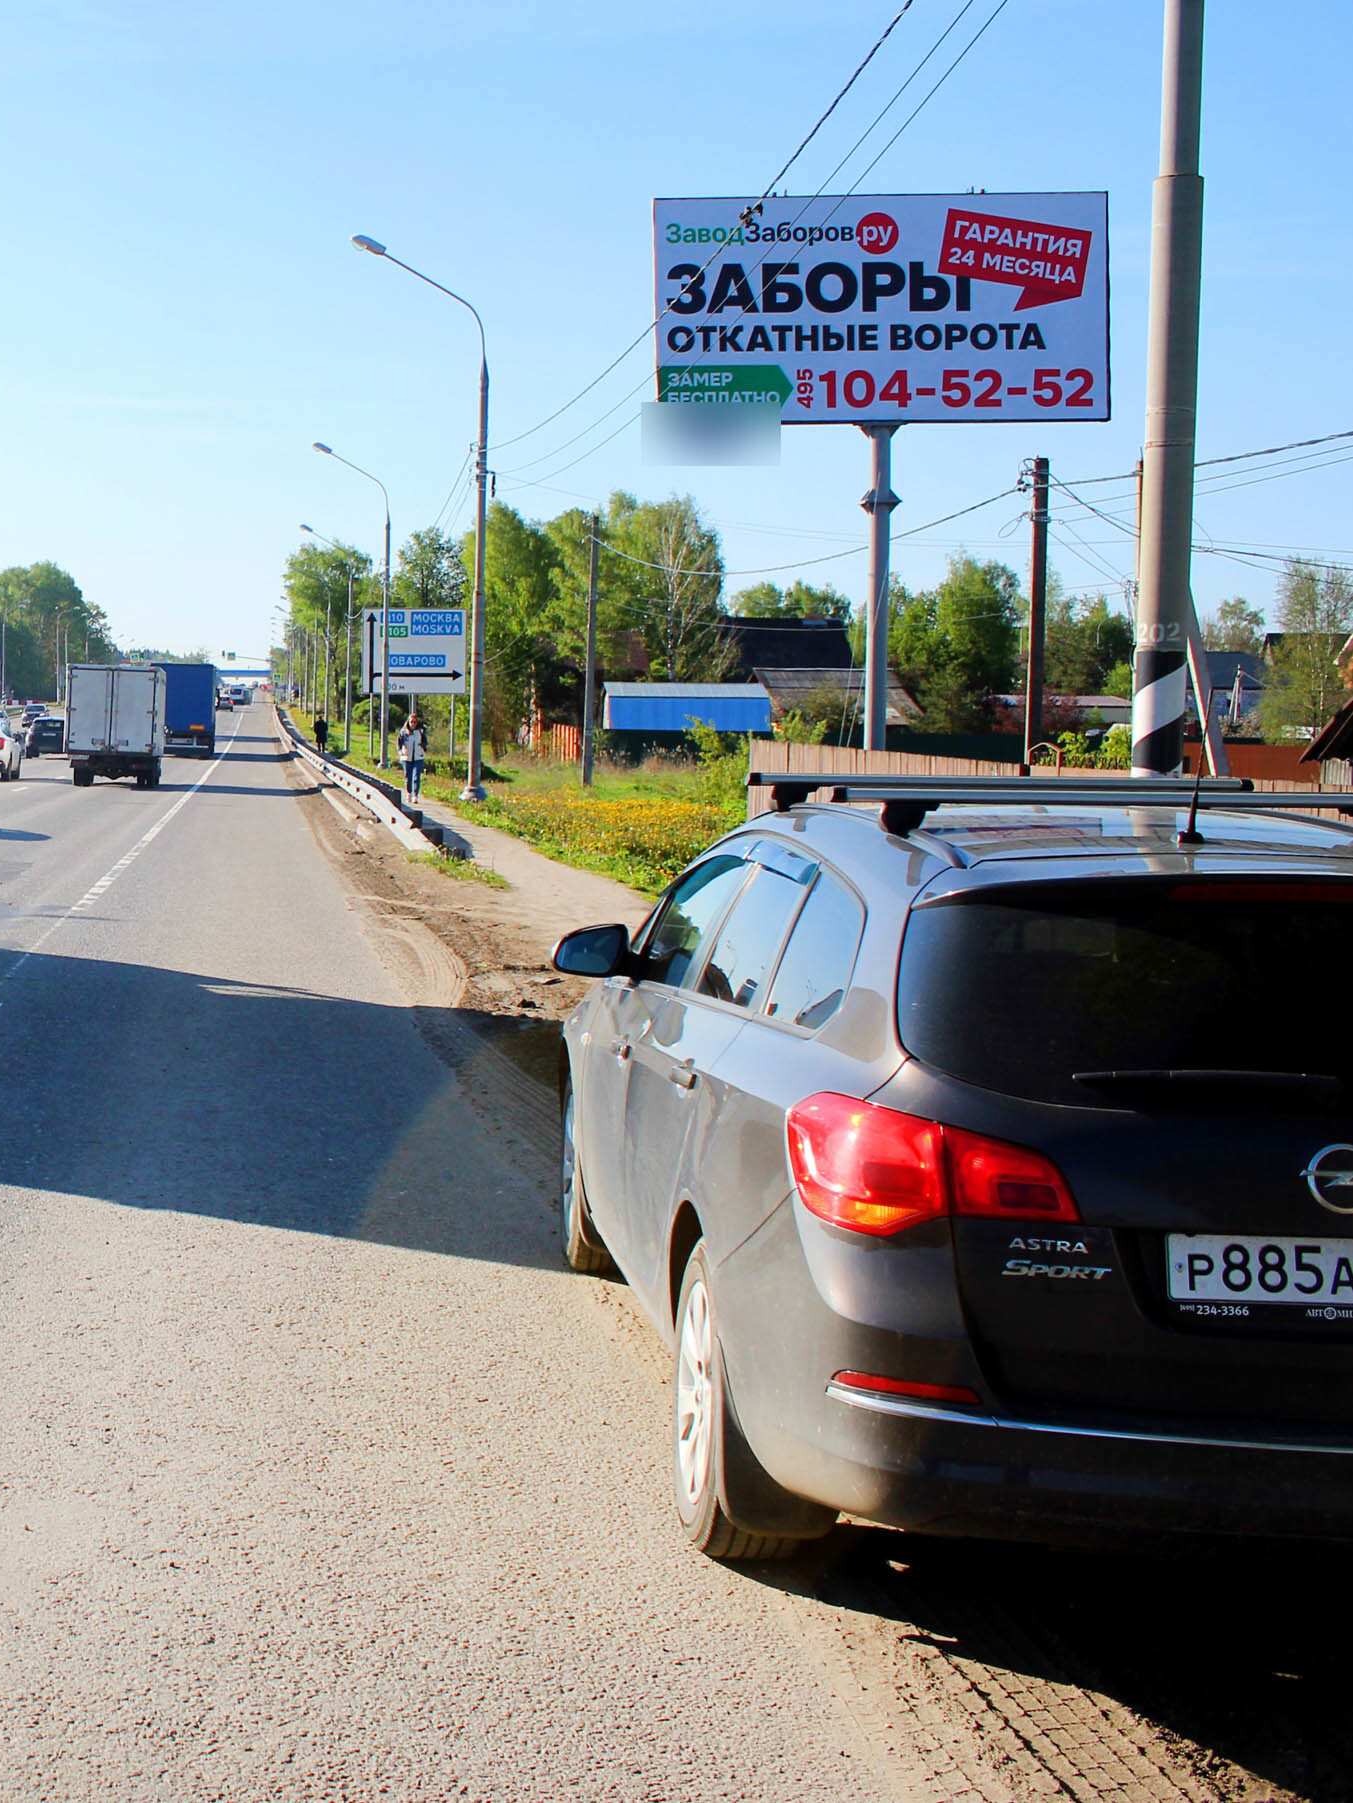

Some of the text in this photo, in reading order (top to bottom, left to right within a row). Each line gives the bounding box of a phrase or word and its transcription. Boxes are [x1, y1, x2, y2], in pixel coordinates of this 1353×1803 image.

[953, 220, 1083, 258] ГАРАНТИЯ
[948, 248, 1077, 284] 24 МЕСЯЦА
[666, 261, 971, 315] ЗАБОРЫ
[666, 323, 1046, 352] ОТКАТНЫЕ ВОРОТА
[667, 372, 733, 387] ЗАМЕР
[796, 368, 1093, 409] 495 104-52-52
[383, 613, 403, 621] 10
[412, 613, 460, 622] МОСКВА
[412, 625, 460, 633] MOSKVA
[389, 656, 444, 665] ОВАРОВО
[1008, 1237, 1088, 1254] ASTRA
[1187, 1243, 1353, 1295] Р885А
[1197, 1305, 1249, 1316] 234-3366
